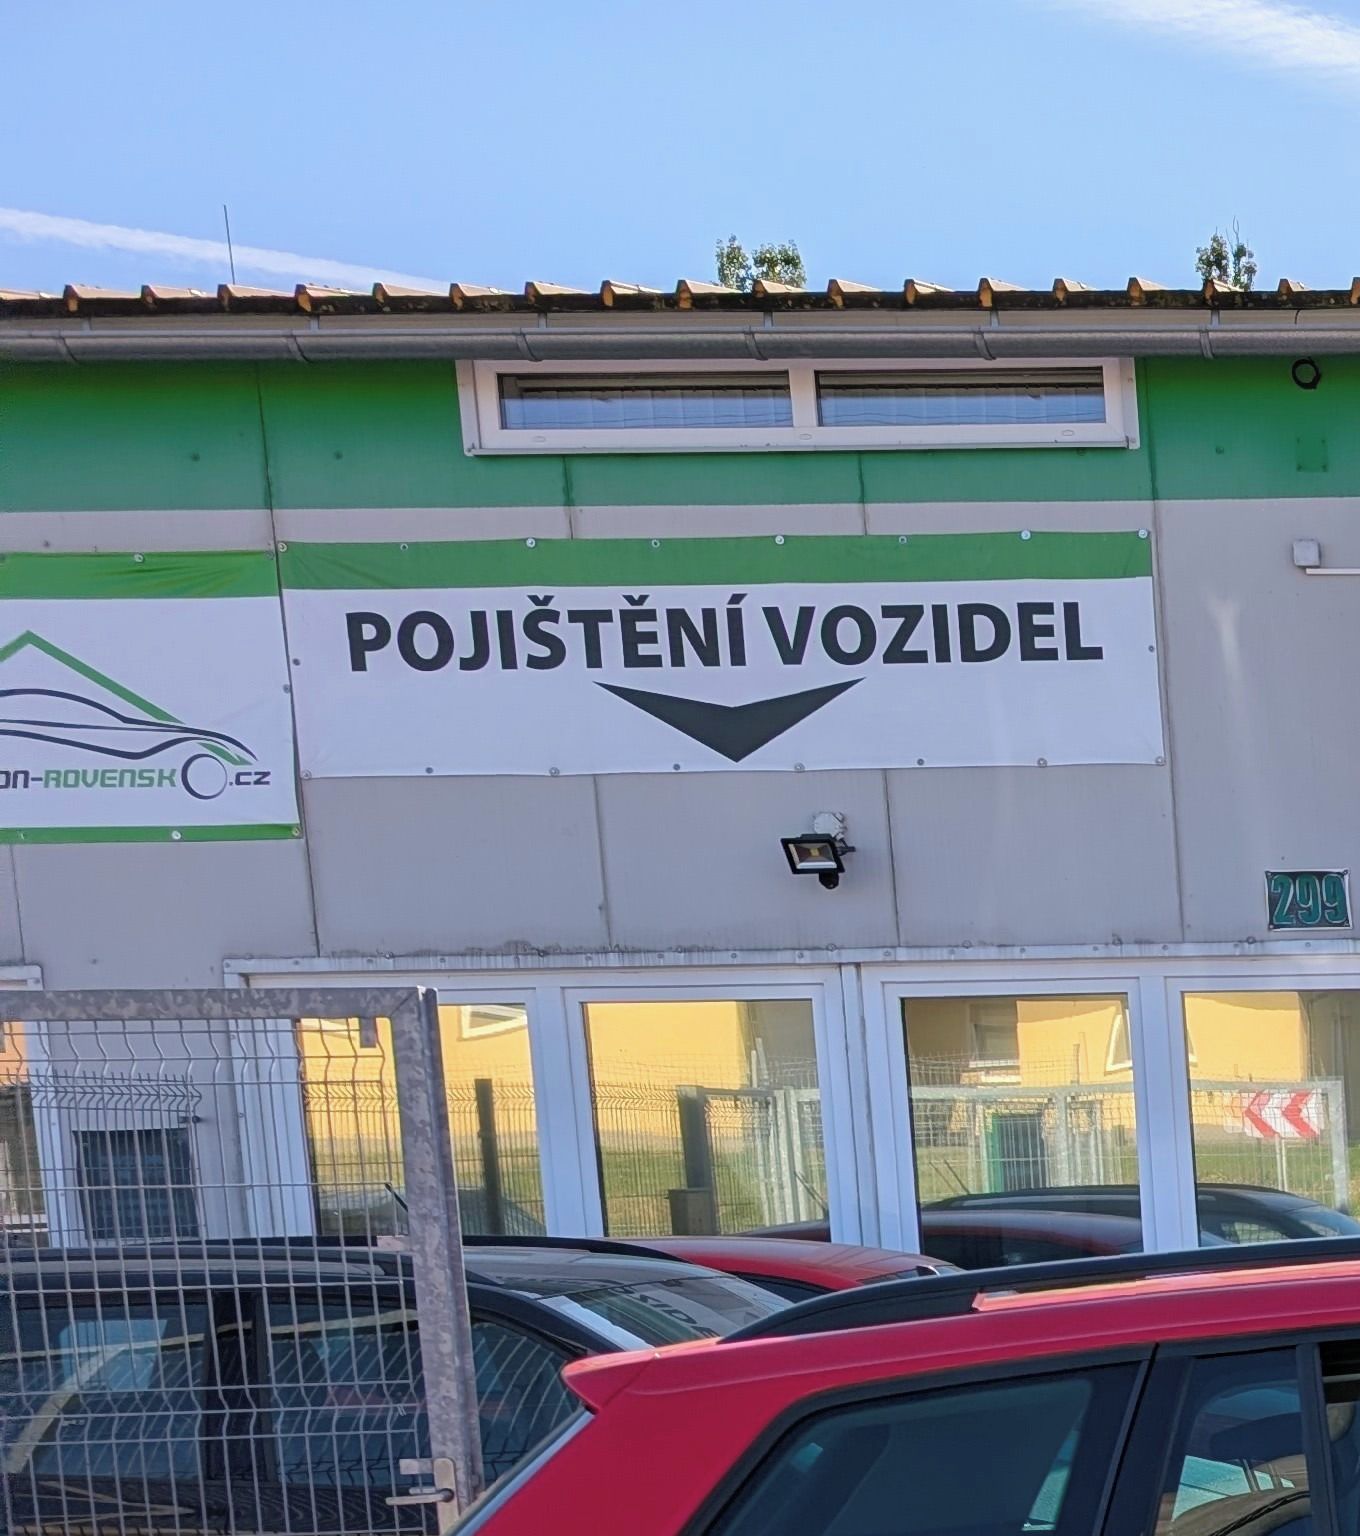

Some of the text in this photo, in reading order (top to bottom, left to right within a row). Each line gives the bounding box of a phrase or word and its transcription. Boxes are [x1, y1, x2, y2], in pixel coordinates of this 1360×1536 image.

[346, 593, 1104, 672] POJIŠTĚNÍ VOZIDEL
[1271, 874, 1348, 925] 299
